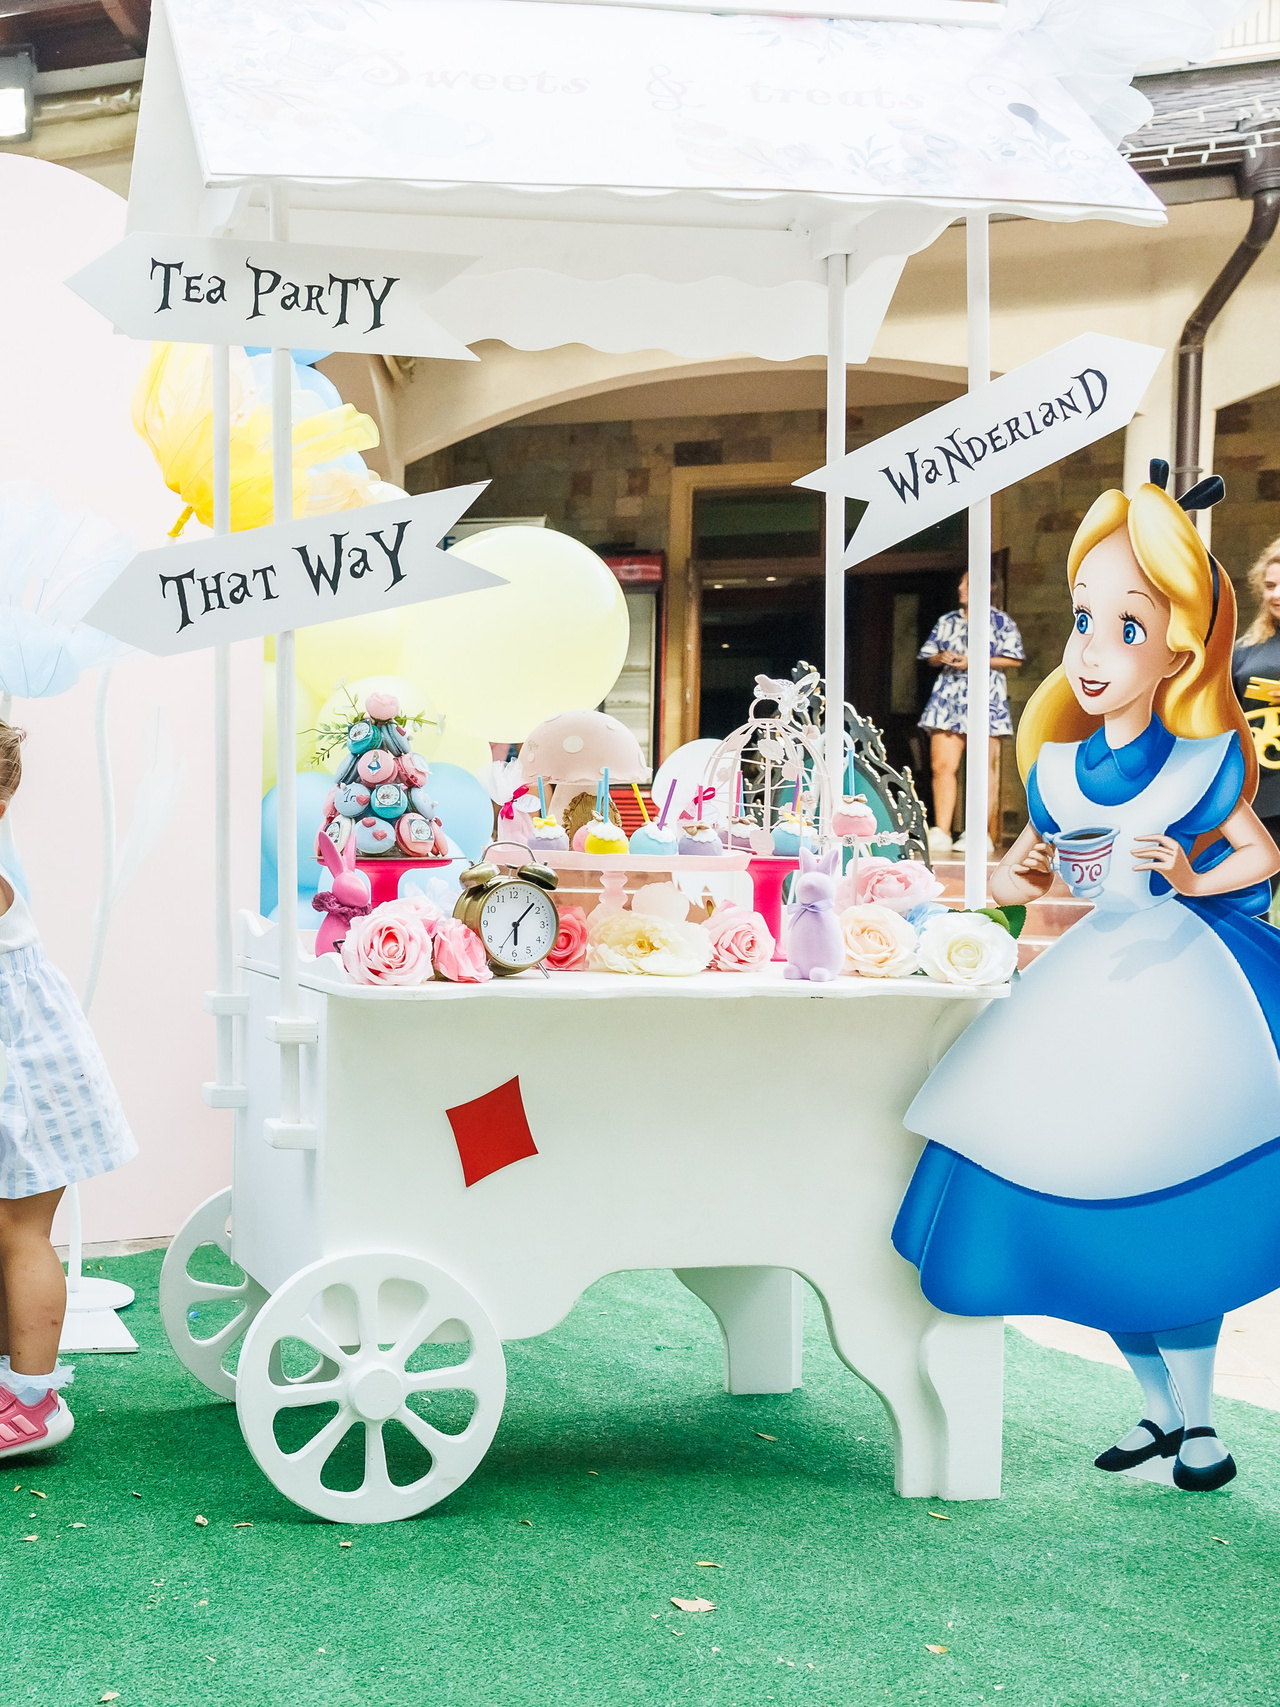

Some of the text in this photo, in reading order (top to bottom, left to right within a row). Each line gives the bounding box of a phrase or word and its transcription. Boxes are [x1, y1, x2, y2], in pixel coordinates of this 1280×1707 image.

[358, 48, 926, 111] Sweets & treats
[496, 895, 505, 903] 11
[509, 891, 519, 899] 12
[526, 896, 530, 904] 1
[487, 905, 496, 914] 10
[535, 906, 541, 915] 2
[482, 920, 489, 928] 9
[539, 920, 546, 929] 3
[487, 935, 493, 943] 8
[535, 936, 541, 944] 4
[511, 950, 518, 958] 6
[526, 946, 532, 954] 5
